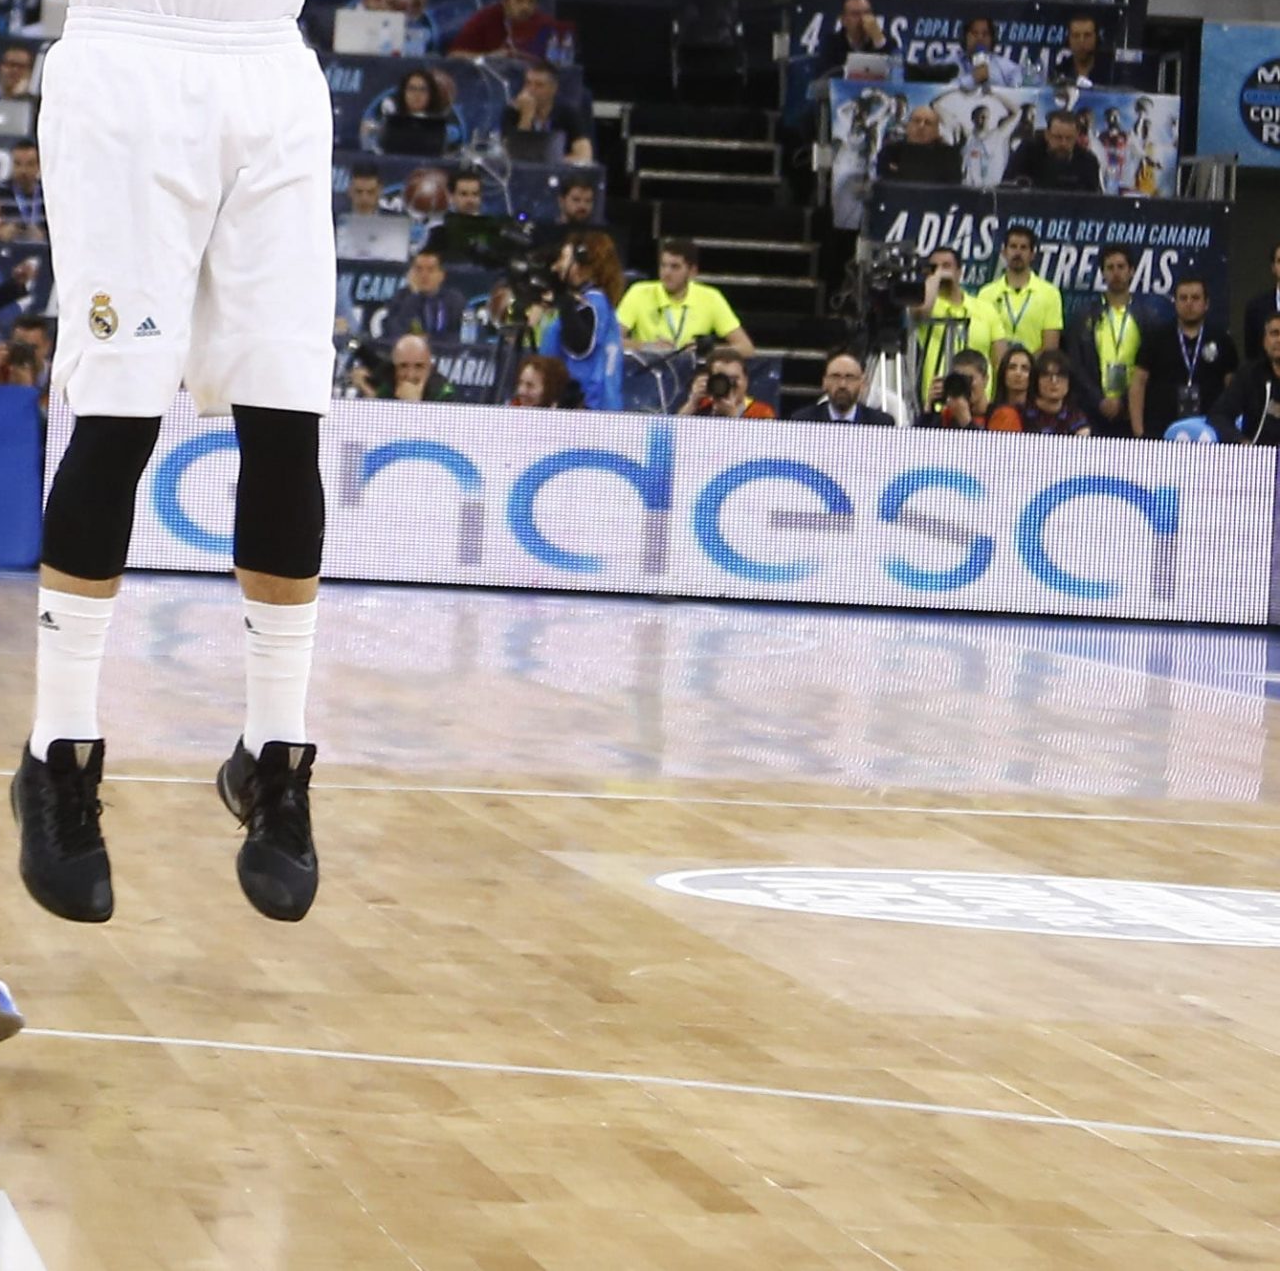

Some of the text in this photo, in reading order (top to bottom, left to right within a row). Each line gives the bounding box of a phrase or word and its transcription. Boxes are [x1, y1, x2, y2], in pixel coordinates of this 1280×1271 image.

[800, 12, 824, 54] 4
[915, 17, 951, 37] COPA
[1007, 20, 1043, 43] GRAN
[916, 203, 1000, 261] DÍAS
[1047, 218, 1073, 241] DEL
[1075, 220, 1105, 242] REY
[1106, 221, 1146, 245] GRAN
[1148, 224, 1212, 248] CANARIA
